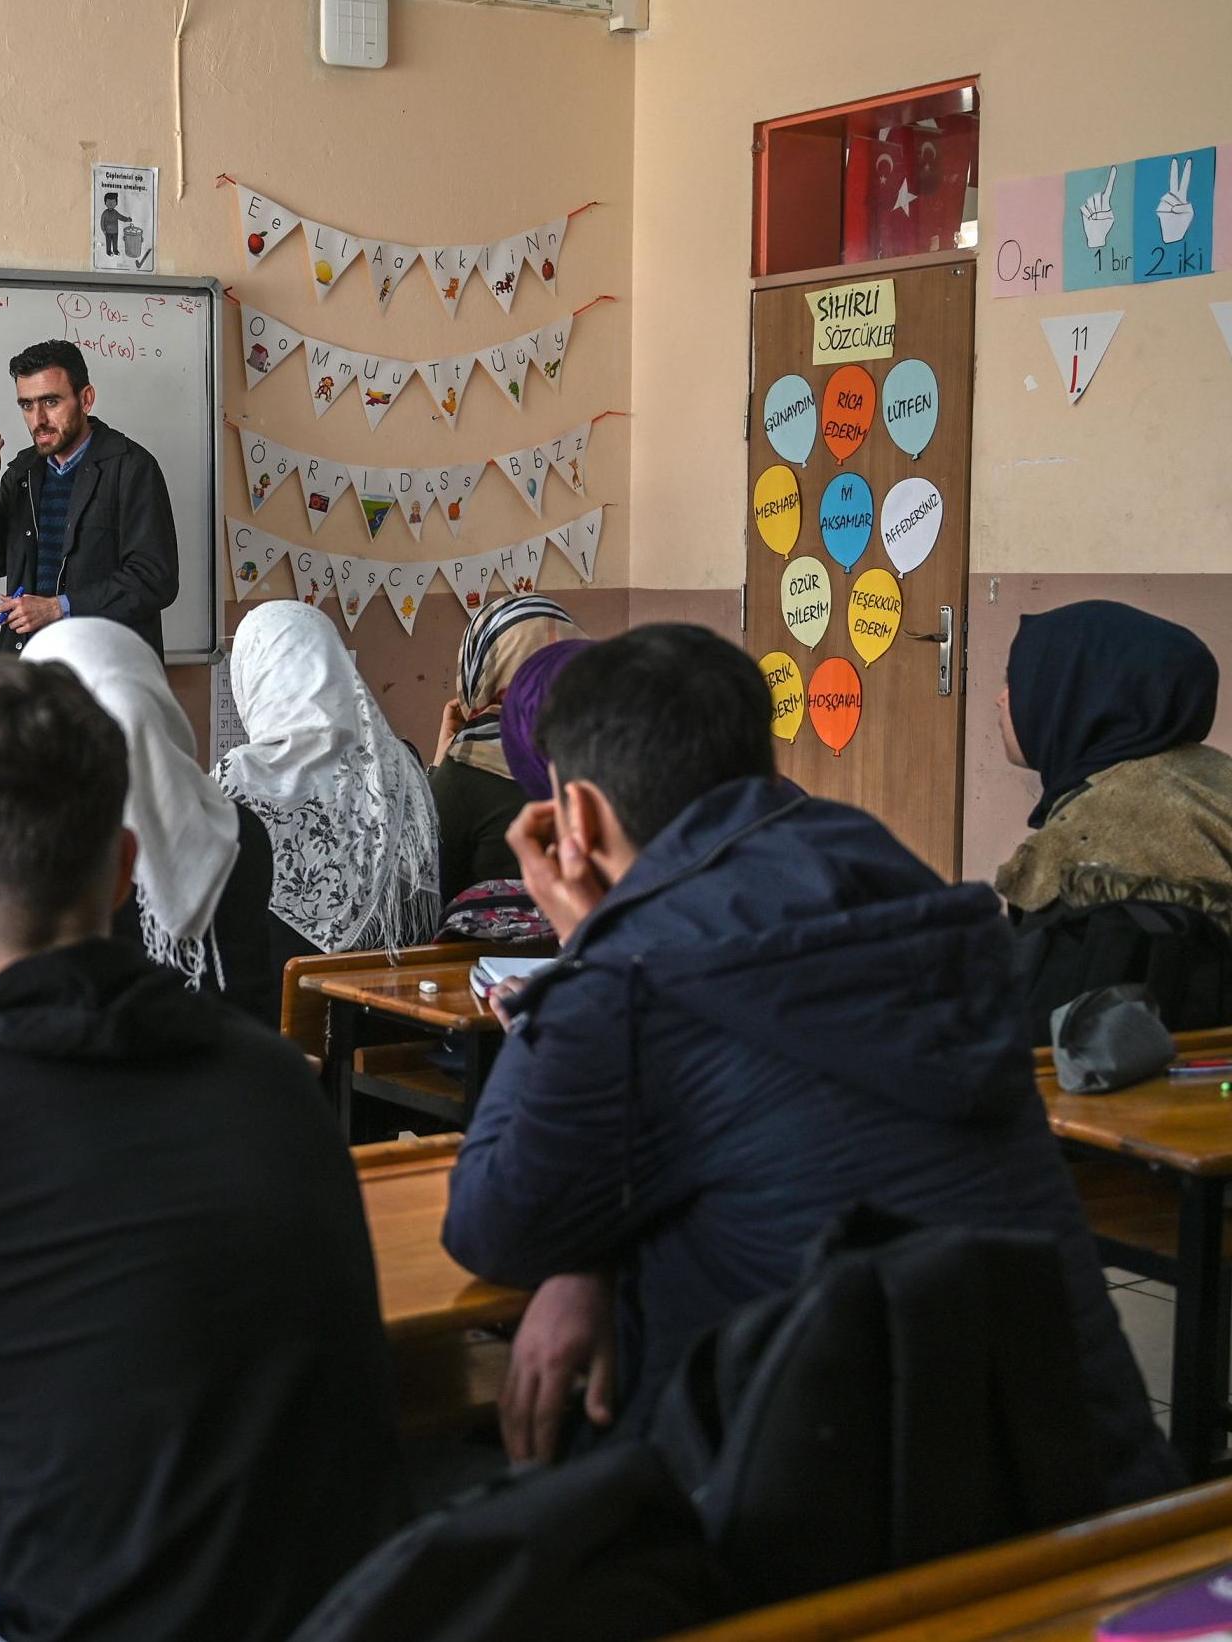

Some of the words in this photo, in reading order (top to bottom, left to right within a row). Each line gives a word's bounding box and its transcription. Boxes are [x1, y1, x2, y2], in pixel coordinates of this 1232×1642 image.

[1094, 250, 1102, 272] 1
[1112, 248, 1132, 271] bir
[1145, 247, 1172, 276] 2
[1179, 242, 1203, 274] iki
[819, 323, 895, 350] SÖZCÜKLER
[1072, 326, 1088, 350] 11
[837, 390, 862, 410] RİCA
[887, 393, 931, 423] LÜTFEN
[765, 395, 815, 432] GÜNAYDIN
[841, 483, 853, 500] İYİ
[755, 492, 800, 520] MERHABA
[885, 493, 940, 546] AFFEDERSİNİZ
[790, 574, 820, 596] ÖZÜR
[787, 601, 829, 627] DİLERİM
[852, 590, 901, 614] TEŞEKKÜR
[854, 619, 892, 638] EDERİM
[808, 694, 862, 711] HOŞÇAKAL
[221, 720, 228, 728] 31
[220, 741, 228, 749] 41
